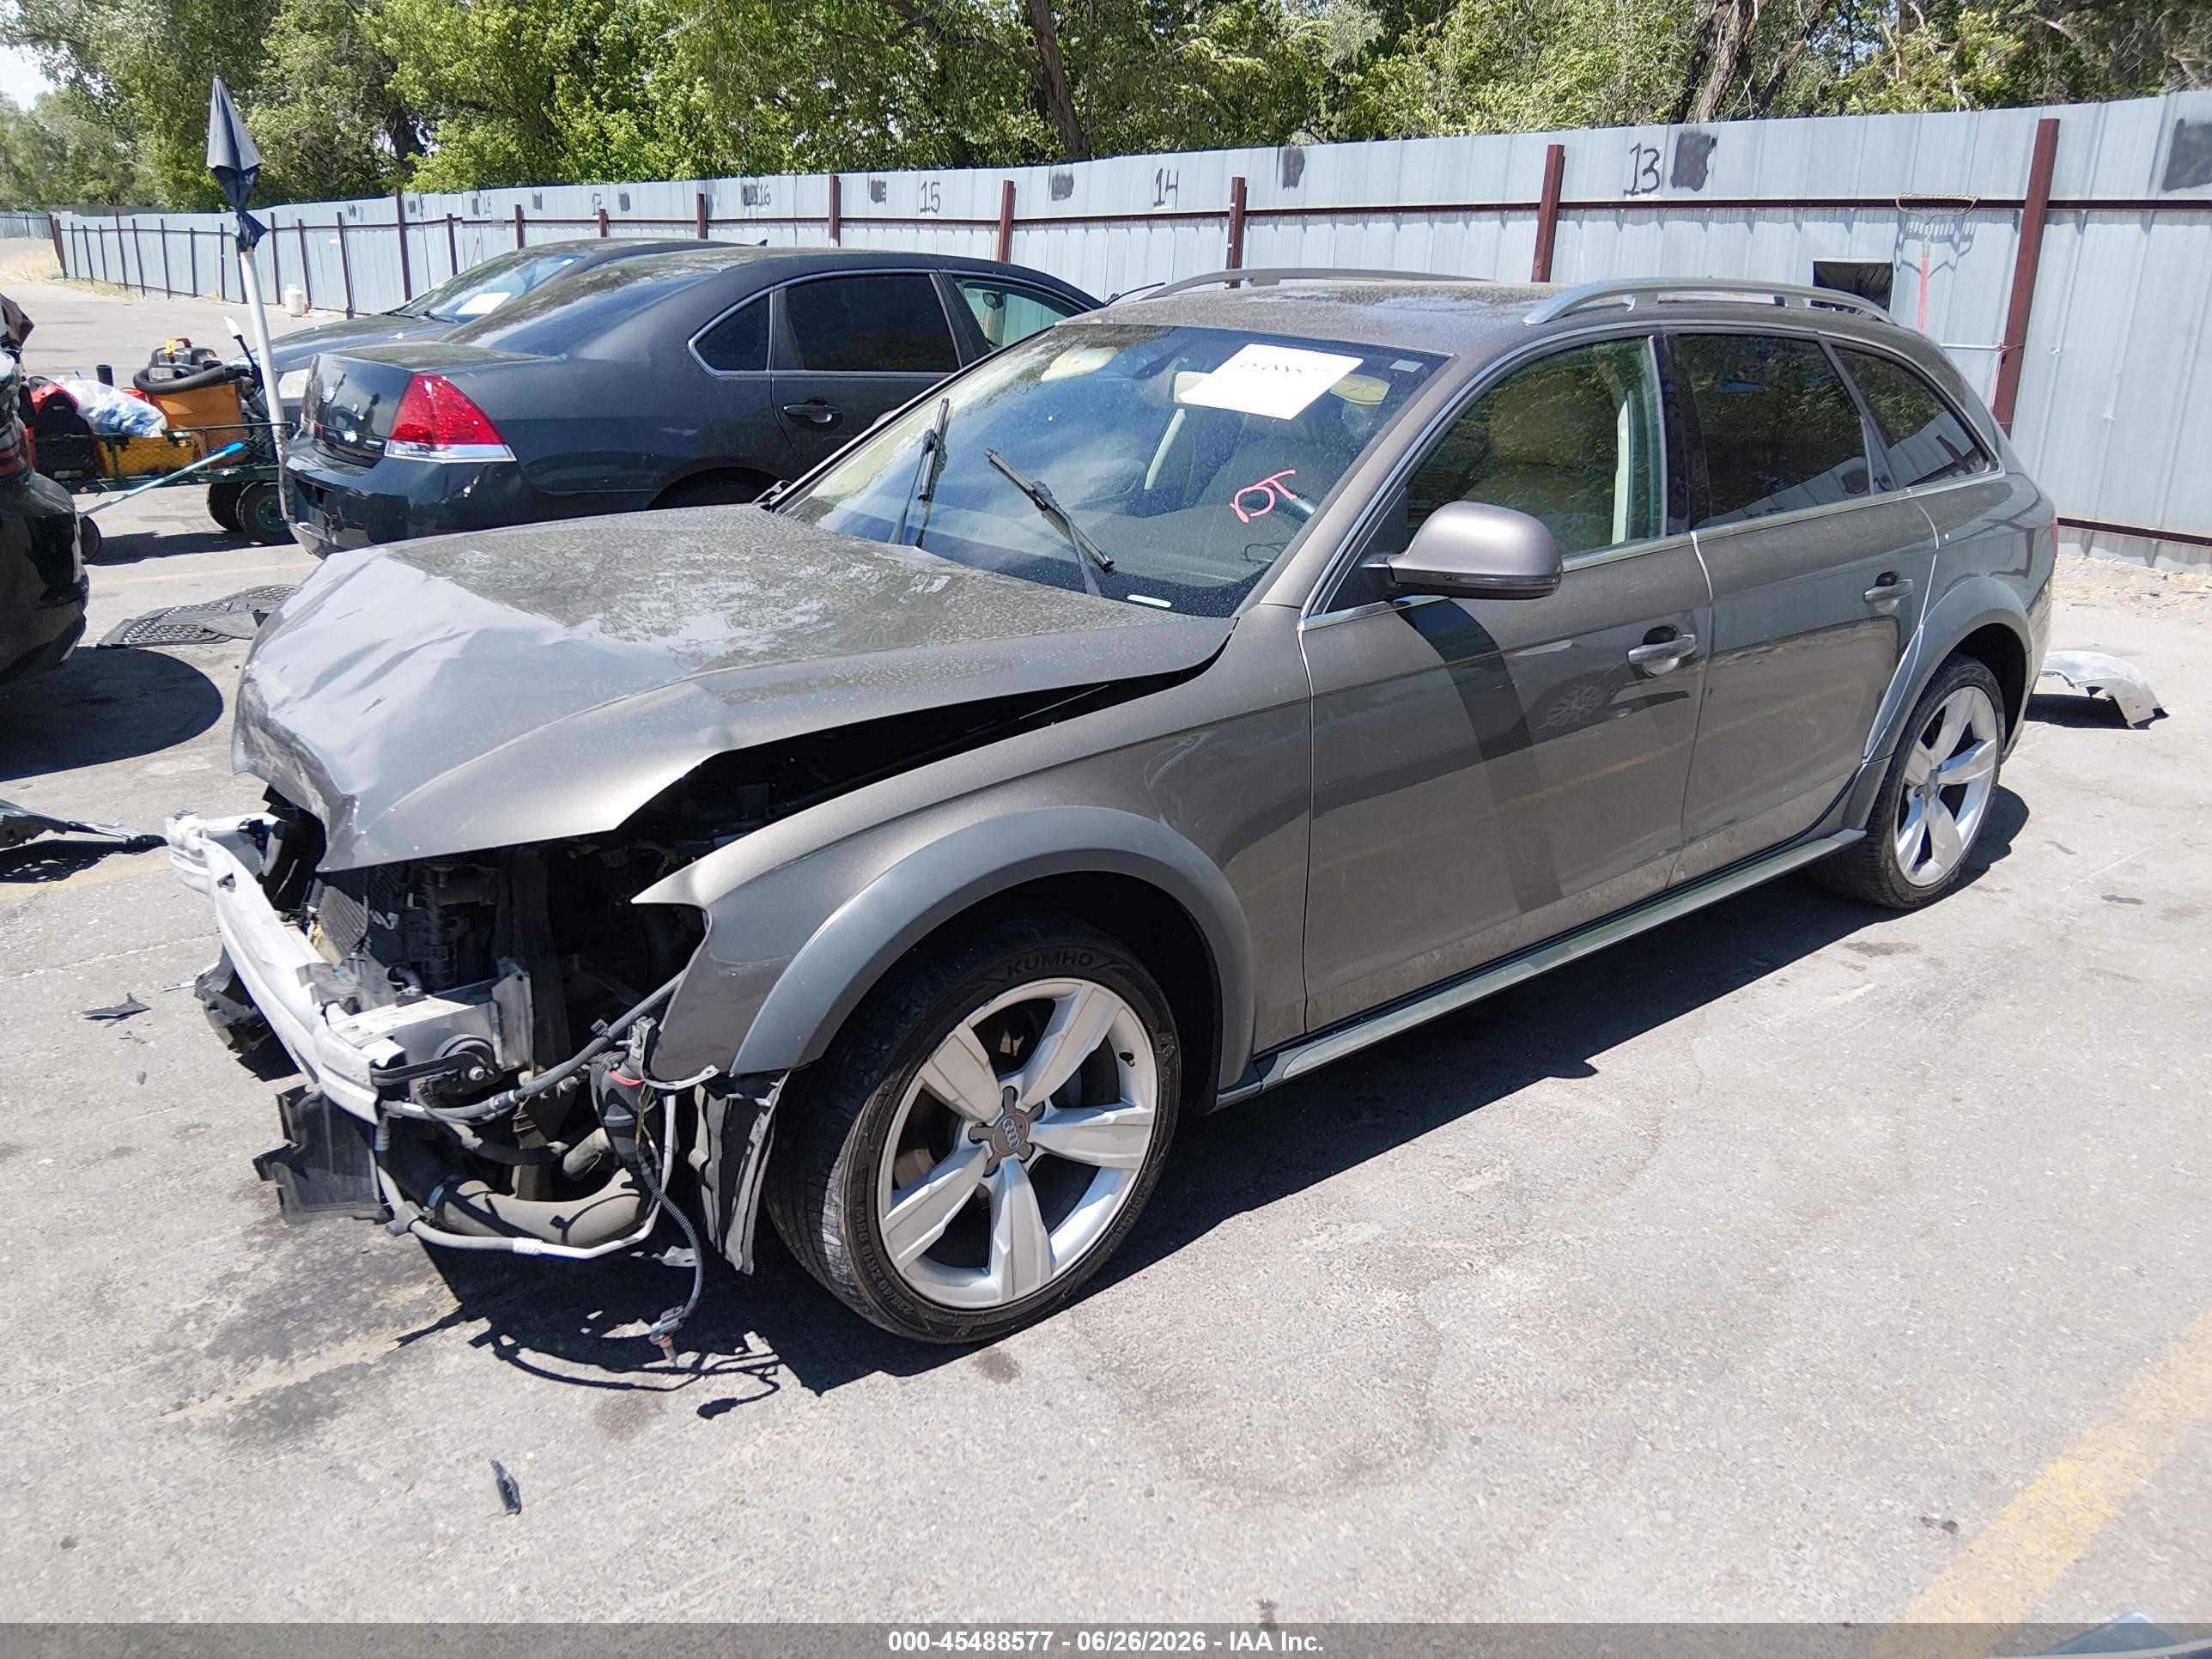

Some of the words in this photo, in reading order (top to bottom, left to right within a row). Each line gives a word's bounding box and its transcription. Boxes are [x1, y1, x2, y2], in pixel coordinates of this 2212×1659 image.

[1624, 143, 1660, 196] 13
[759, 184, 771, 206] 16
[920, 180, 940, 213] 15
[1153, 167, 1179, 212] 14
[1006, 951, 1093, 977] KUMHO
